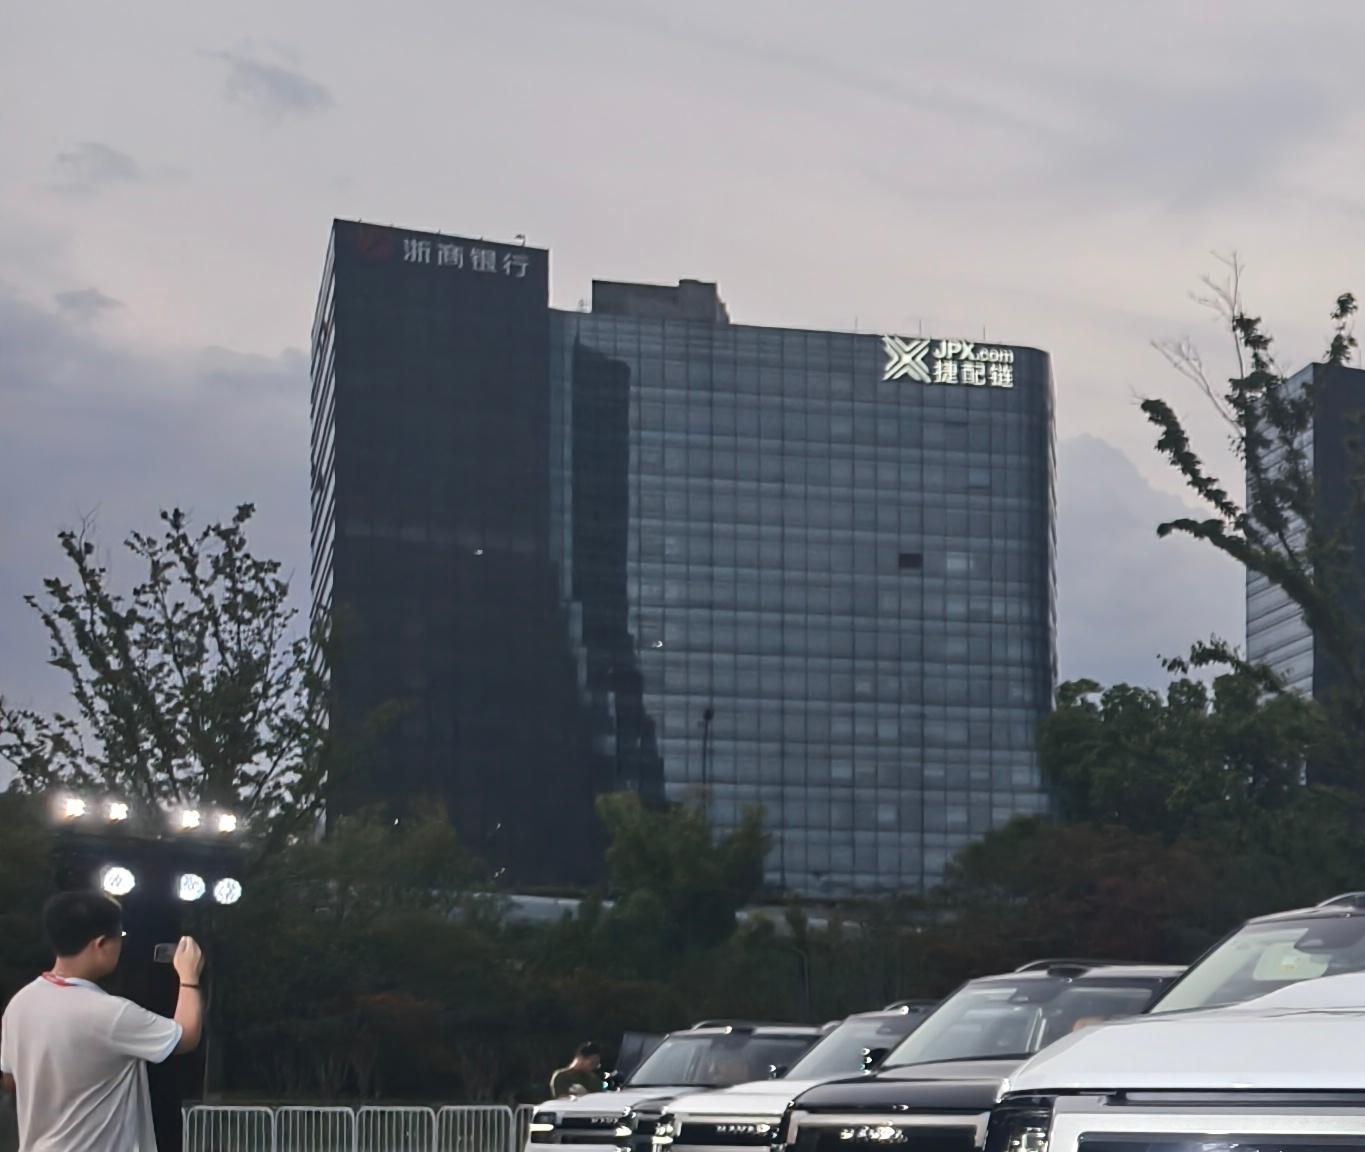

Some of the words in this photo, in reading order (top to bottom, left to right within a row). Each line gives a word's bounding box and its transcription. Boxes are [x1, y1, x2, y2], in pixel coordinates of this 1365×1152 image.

[403, 239, 529, 278] 浙商银行
[933, 339, 1014, 362] JPX.com
[933, 360, 1014, 388] 捷配链
